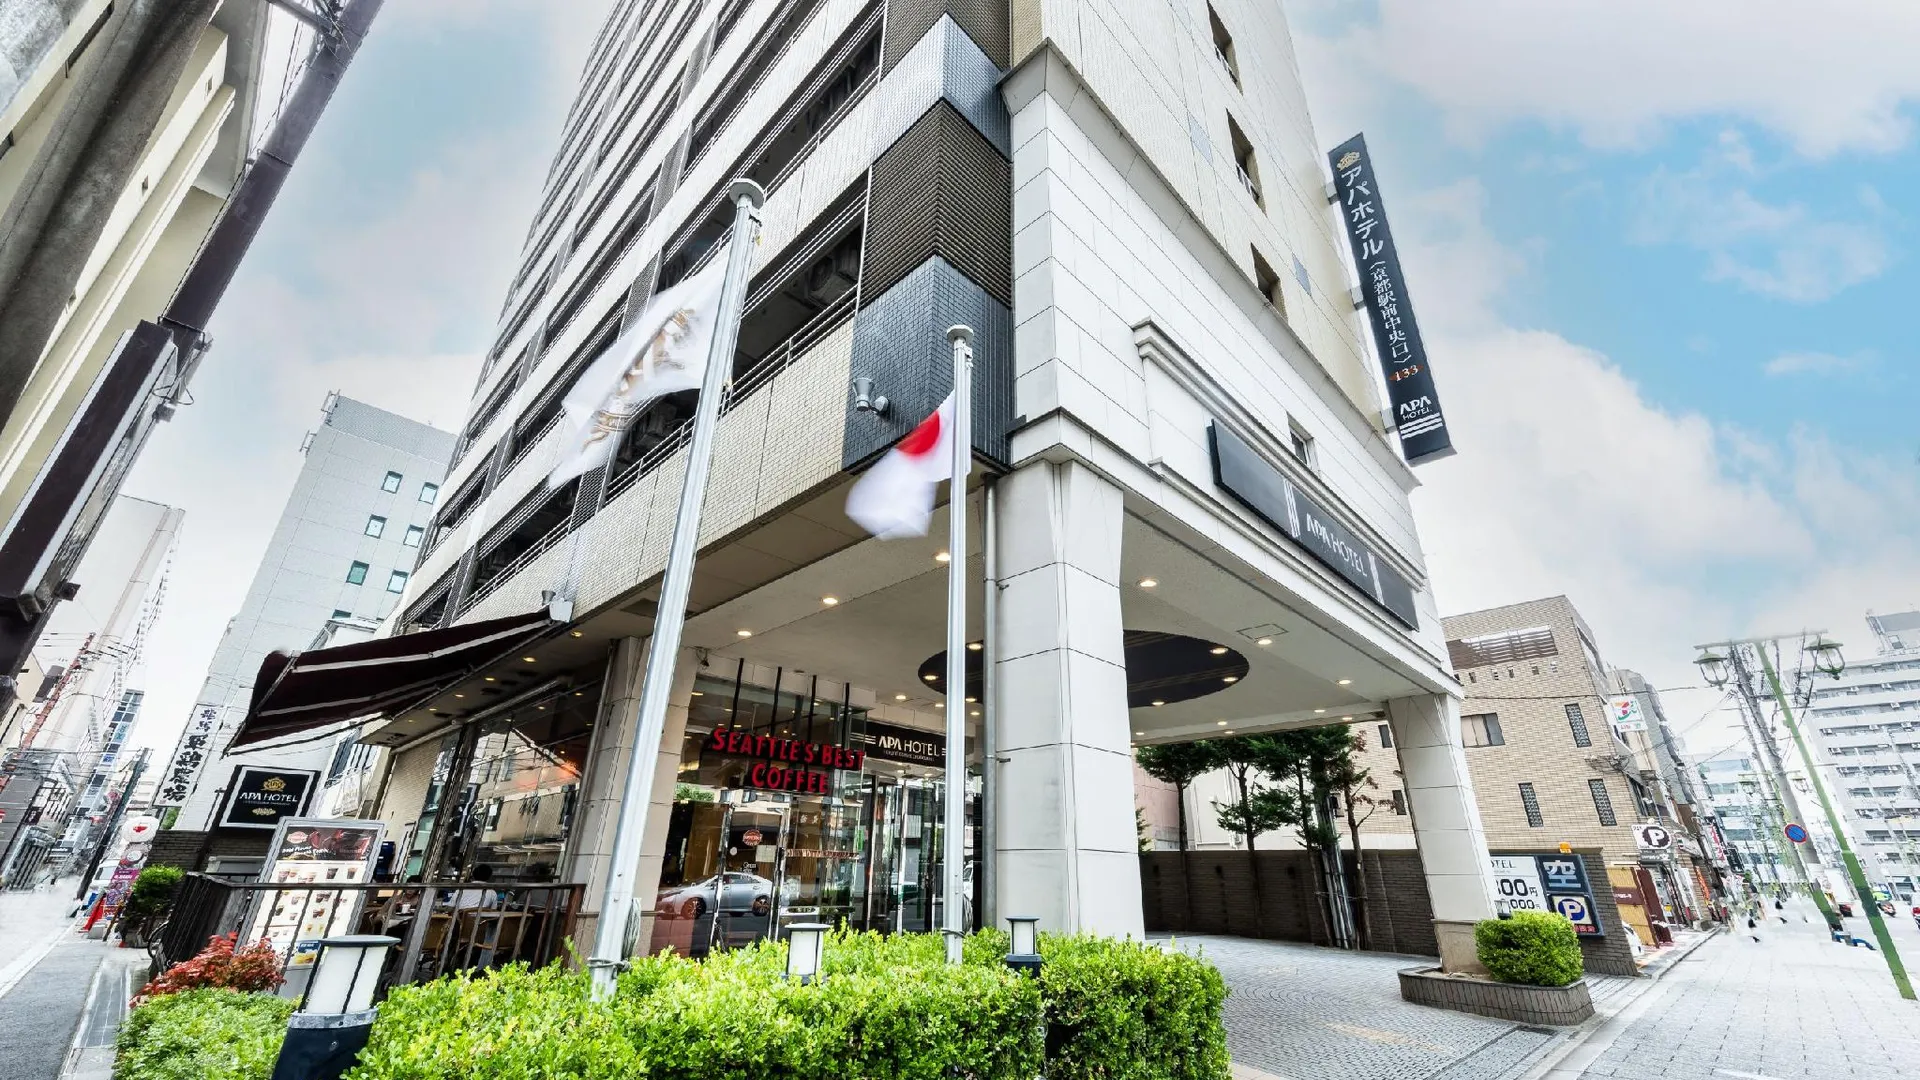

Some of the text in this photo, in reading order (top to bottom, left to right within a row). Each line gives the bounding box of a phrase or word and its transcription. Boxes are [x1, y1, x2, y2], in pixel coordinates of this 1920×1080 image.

[1341, 164, 1384, 260] アパホテル
[1400, 395, 1432, 415] APA
[1402, 408, 1433, 421] HOTEL
[1306, 513, 1367, 577] APA HOTEL
[712, 727, 814, 763] SEATTLE'S
[821, 743, 865, 771] BEST
[878, 735, 902, 751] APA
[904, 739, 940, 757] HOTEL
[751, 763, 829, 793] COFFEE
[240, 792, 262, 801] APA
[263, 792, 298, 803] HOTEL
[1542, 859, 1582, 888] 空
